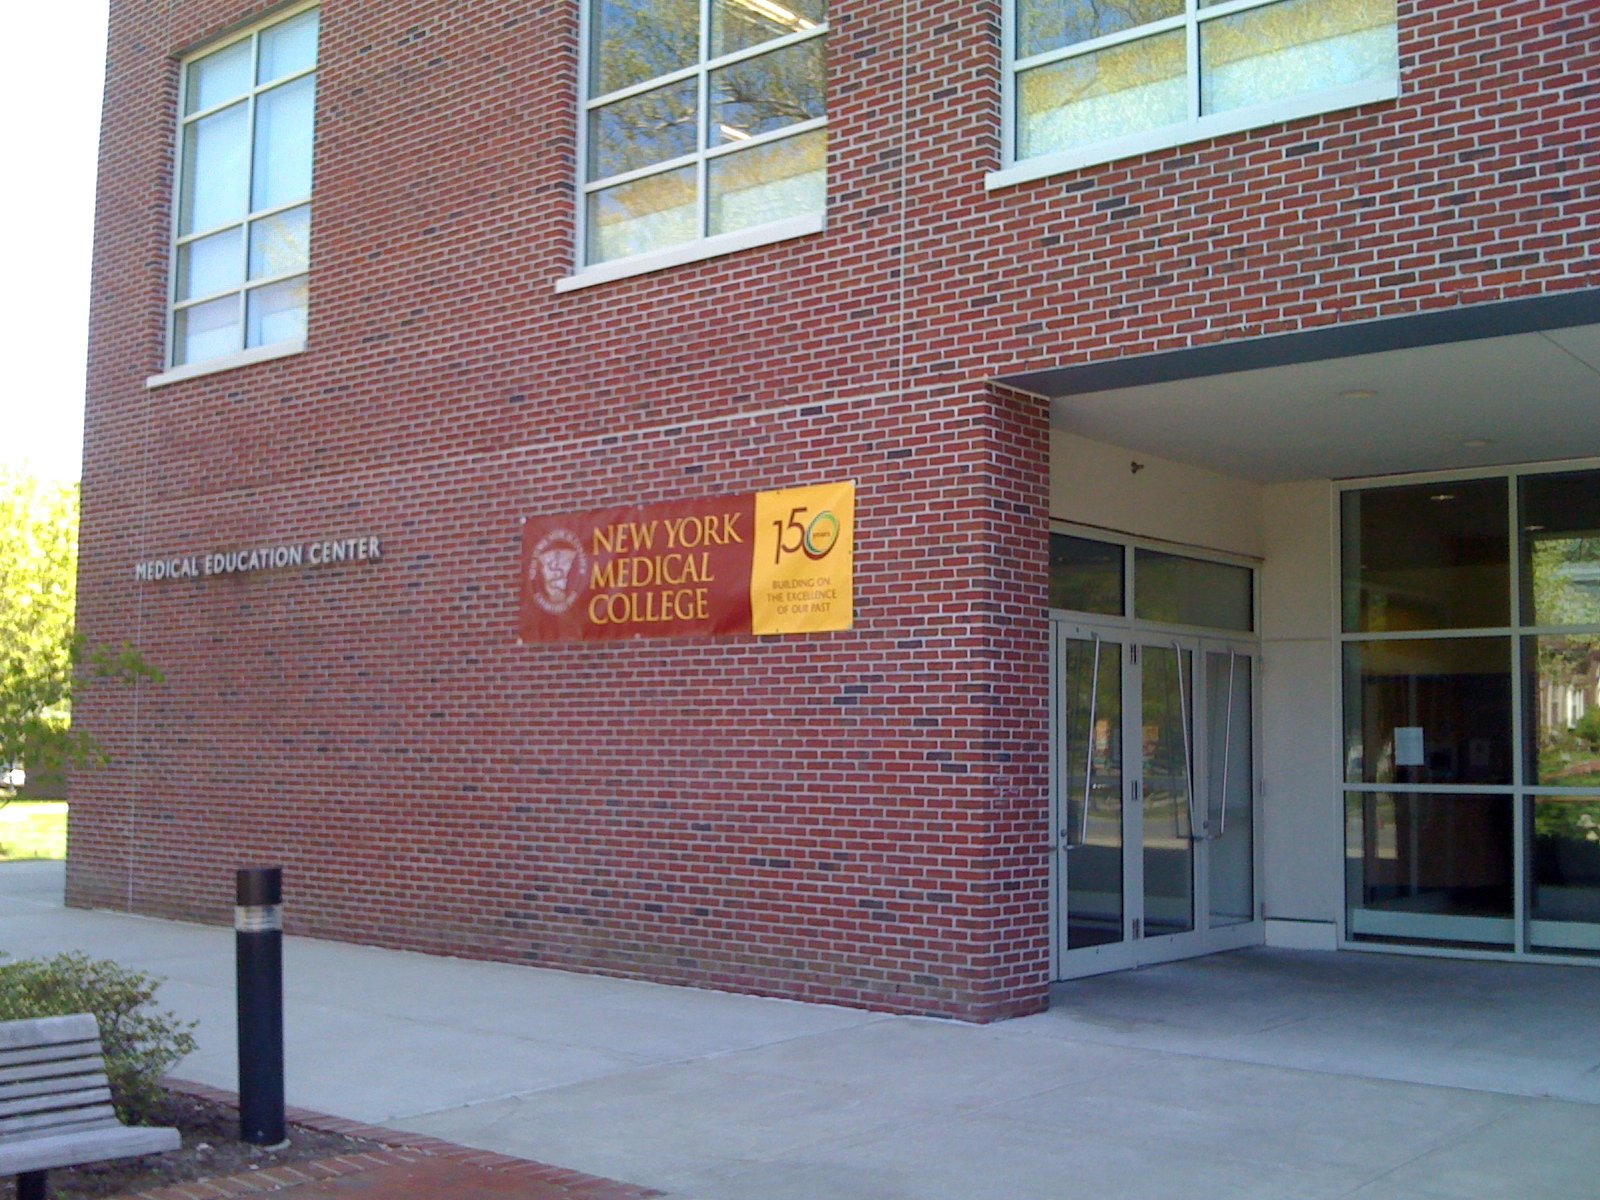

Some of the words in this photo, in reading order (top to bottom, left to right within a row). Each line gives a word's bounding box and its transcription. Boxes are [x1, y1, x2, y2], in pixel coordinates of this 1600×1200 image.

[593, 520, 658, 555] NEW
[664, 512, 744, 548] YORK
[772, 507, 840, 565] 150
[136, 556, 199, 581] MEDICAL
[205, 546, 303, 575] EDUCATION
[310, 536, 380, 564] CENTER
[589, 552, 715, 590] MEDICAL
[767, 593, 784, 602] THE
[787, 589, 837, 601] EXCELLENCE
[772, 579, 815, 590] BUILDING
[817, 577, 831, 586] ON
[588, 588, 709, 624] COLLEGE
[777, 605, 789, 614] OF
[791, 603, 810, 613] OUR
[811, 602, 832, 612] PAST
